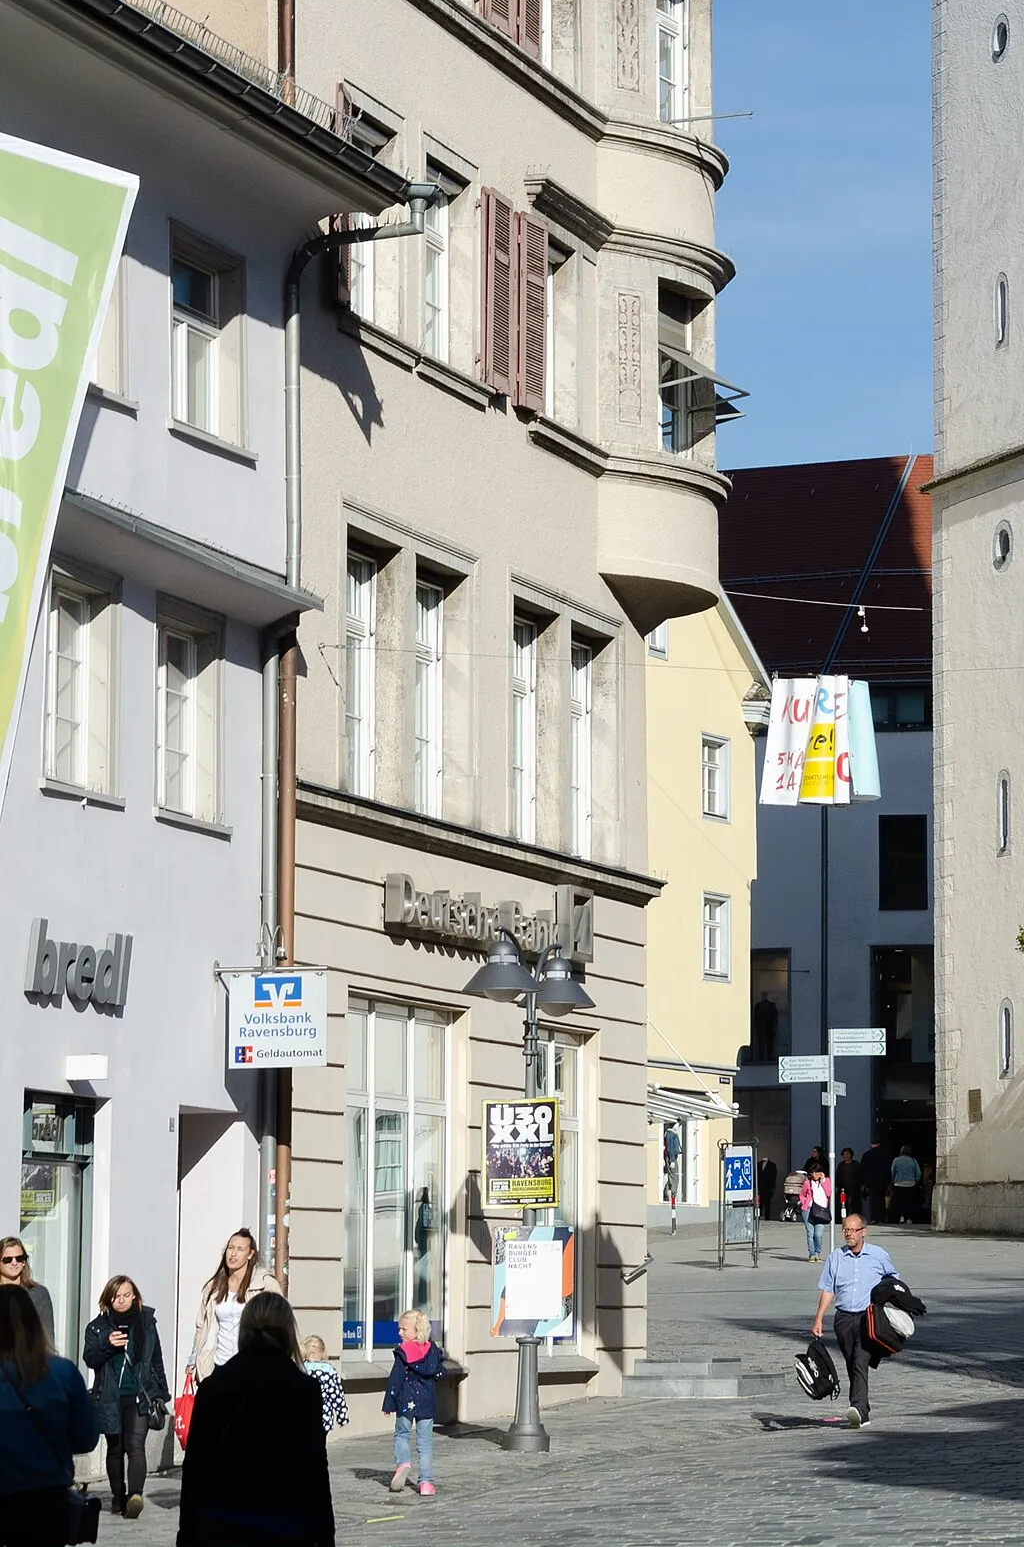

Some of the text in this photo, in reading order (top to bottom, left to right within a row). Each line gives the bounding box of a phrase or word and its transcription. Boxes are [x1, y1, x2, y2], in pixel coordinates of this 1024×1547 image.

[385, 872, 500, 940] Deutsche
[24, 918, 133, 1008] bredl
[244, 1012, 312, 1024] Volksbank
[239, 1025, 317, 1039] Ravensburg
[256, 1048, 323, 1058] Geldautomat
[490, 1105, 553, 1126] Ü30
[489, 1123, 554, 1143] XXL
[511, 1179, 552, 1187] RAVENSBURG
